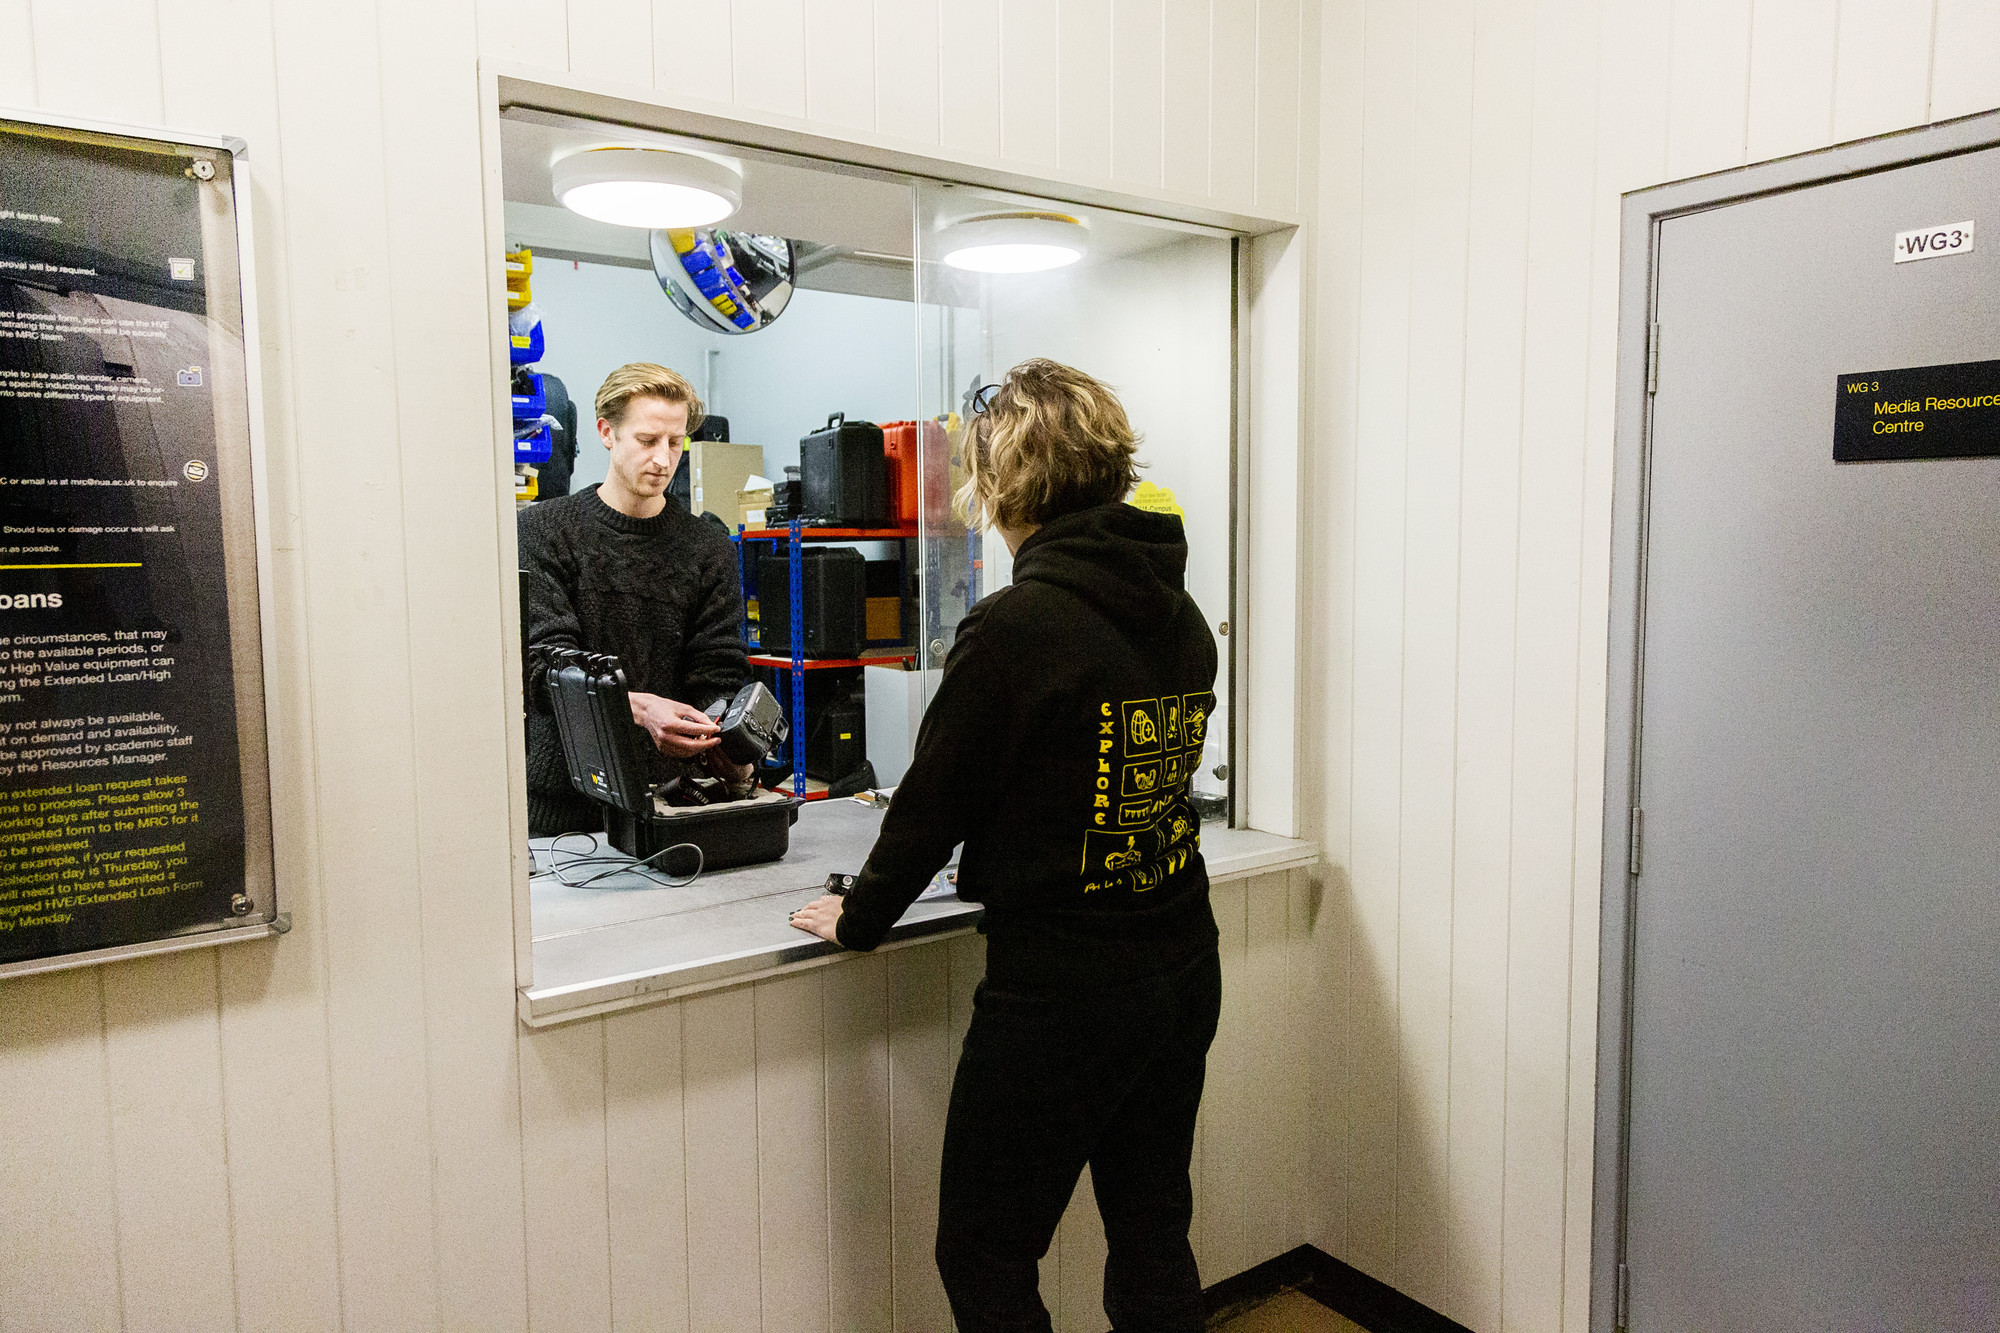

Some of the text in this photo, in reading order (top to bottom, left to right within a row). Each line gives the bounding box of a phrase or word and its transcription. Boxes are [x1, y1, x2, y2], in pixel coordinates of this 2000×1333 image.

[1905, 230, 1963, 254] WG3
[28, 262, 44, 271] will
[45, 263, 58, 272] be
[60, 266, 98, 276] required.
[17, 312, 56, 321] proposal
[82, 317, 99, 326] you
[136, 320, 150, 328] the
[151, 321, 170, 329] HVE
[39, 323, 54, 331] the
[55, 325, 102, 334] equipment
[103, 327, 118, 335] will
[119, 328, 131, 336] be
[15, 330, 39, 340] MRC
[20, 370, 31, 378] to
[32, 372, 49, 380] use
[50, 373, 75, 381] audio
[9, 381, 44, 390] specific
[95, 384, 119, 393] these
[120, 386, 140, 396] may
[17, 391, 42, 399] some
[43, 391, 80, 400] different
[81, 393, 105, 403] types
[1846, 380, 1880, 395] WG 3
[1873, 393, 2000, 416] Media Resource
[1872, 419, 1925, 435] Centre
[21, 478, 46, 486] email
[147, 480, 179, 488] enquire
[3, 525, 35, 534] Should
[37, 525, 56, 533] loss
[67, 525, 104, 536] damage
[104, 526, 130, 534] occur
[145, 525, 159, 534] will
[160, 525, 176, 533] ask
[9, 546, 20, 554] as
[13, 631, 111, 646] circumstances,
[114, 629, 139, 641] that
[141, 629, 168, 641] may
[13, 648, 36, 659] the
[38, 645, 94, 658] available
[97, 643, 148, 657] periods,
[150, 644, 165, 653] or
[11, 662, 42, 675] High
[44, 658, 80, 672] Value
[82, 656, 150, 671] equipment
[152, 656, 175, 666] can
[20, 676, 41, 688] the
[44, 672, 105, 687] Extended
[107, 669, 172, 683] Loan/High
[15, 720, 37, 731] not
[40, 715, 86, 730] always
[87, 715, 105, 726] be
[107, 710, 165, 725] available,
[10, 735, 28, 746] on
[30, 729, 84, 744] demand
[87, 728, 111, 739] and
[114, 724, 181, 738] availability.
[0, 735, 194, 761] be approved by academic staff
[17, 762, 39, 774] the
[42, 756, 110, 771] Resources
[112, 751, 169, 766] Manager.
[1093, 702, 1114, 826] EXPLORE
[11, 783, 73, 799] extended
[75, 782, 104, 794] loan
[105, 777, 152, 791] request
[154, 775, 188, 787] takes
[22, 801, 38, 813] to
[39, 797, 96, 812] process.
[98, 793, 141, 806] Please
[142, 790, 175, 801] allow
[176, 787, 186, 798] 3
[46, 812, 79, 825] days
[81, 808, 111, 821] after
[112, 802, 178, 818] submitting
[180, 799, 200, 811] the
[0, 812, 200, 843] ompleted form to the MRC for it
[10, 846, 29, 857] be
[94, 850, 122, 864] your
[123, 841, 187, 858] requested
[61, 867, 86, 880] day
[88, 864, 101, 876] is
[165, 856, 189, 868] you
[21, 884, 55, 898] need
[57, 882, 72, 894] to
[74, 879, 106, 892] have
[167, 871, 177, 881] a
[45, 889, 138, 909] HVE/Extended
[139, 884, 171, 898] Loan
[172, 880, 204, 893] Form
